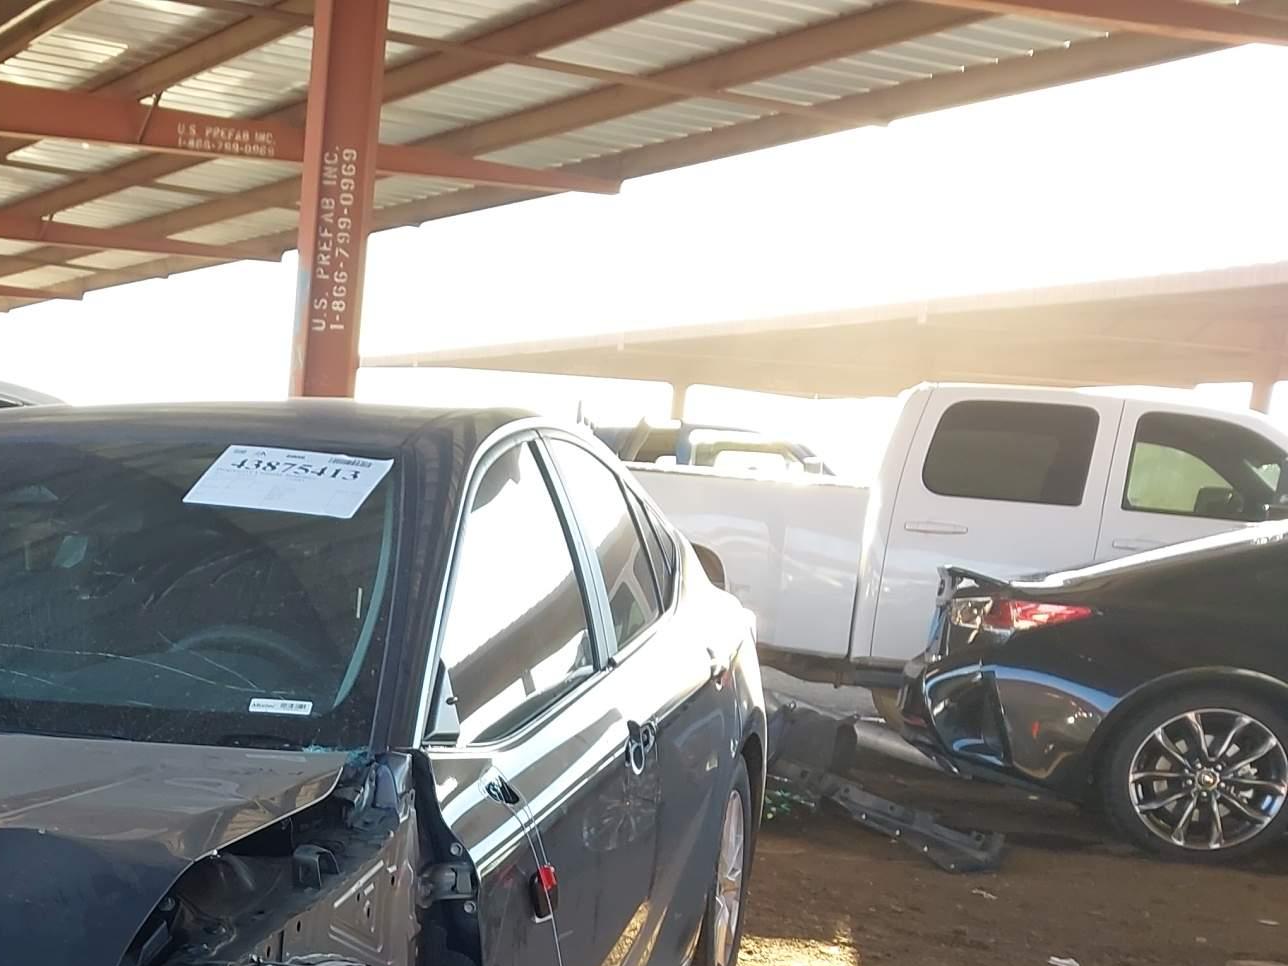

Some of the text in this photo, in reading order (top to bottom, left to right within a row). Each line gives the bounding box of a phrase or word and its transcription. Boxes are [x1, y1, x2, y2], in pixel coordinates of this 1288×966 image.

[205, 126, 250, 141] PREFAB
[312, 145, 340, 332] U.S. PREFAB INC.
[330, 148, 357, 330] 1-866-799-0969
[231, 458, 361, 481] 43875413
